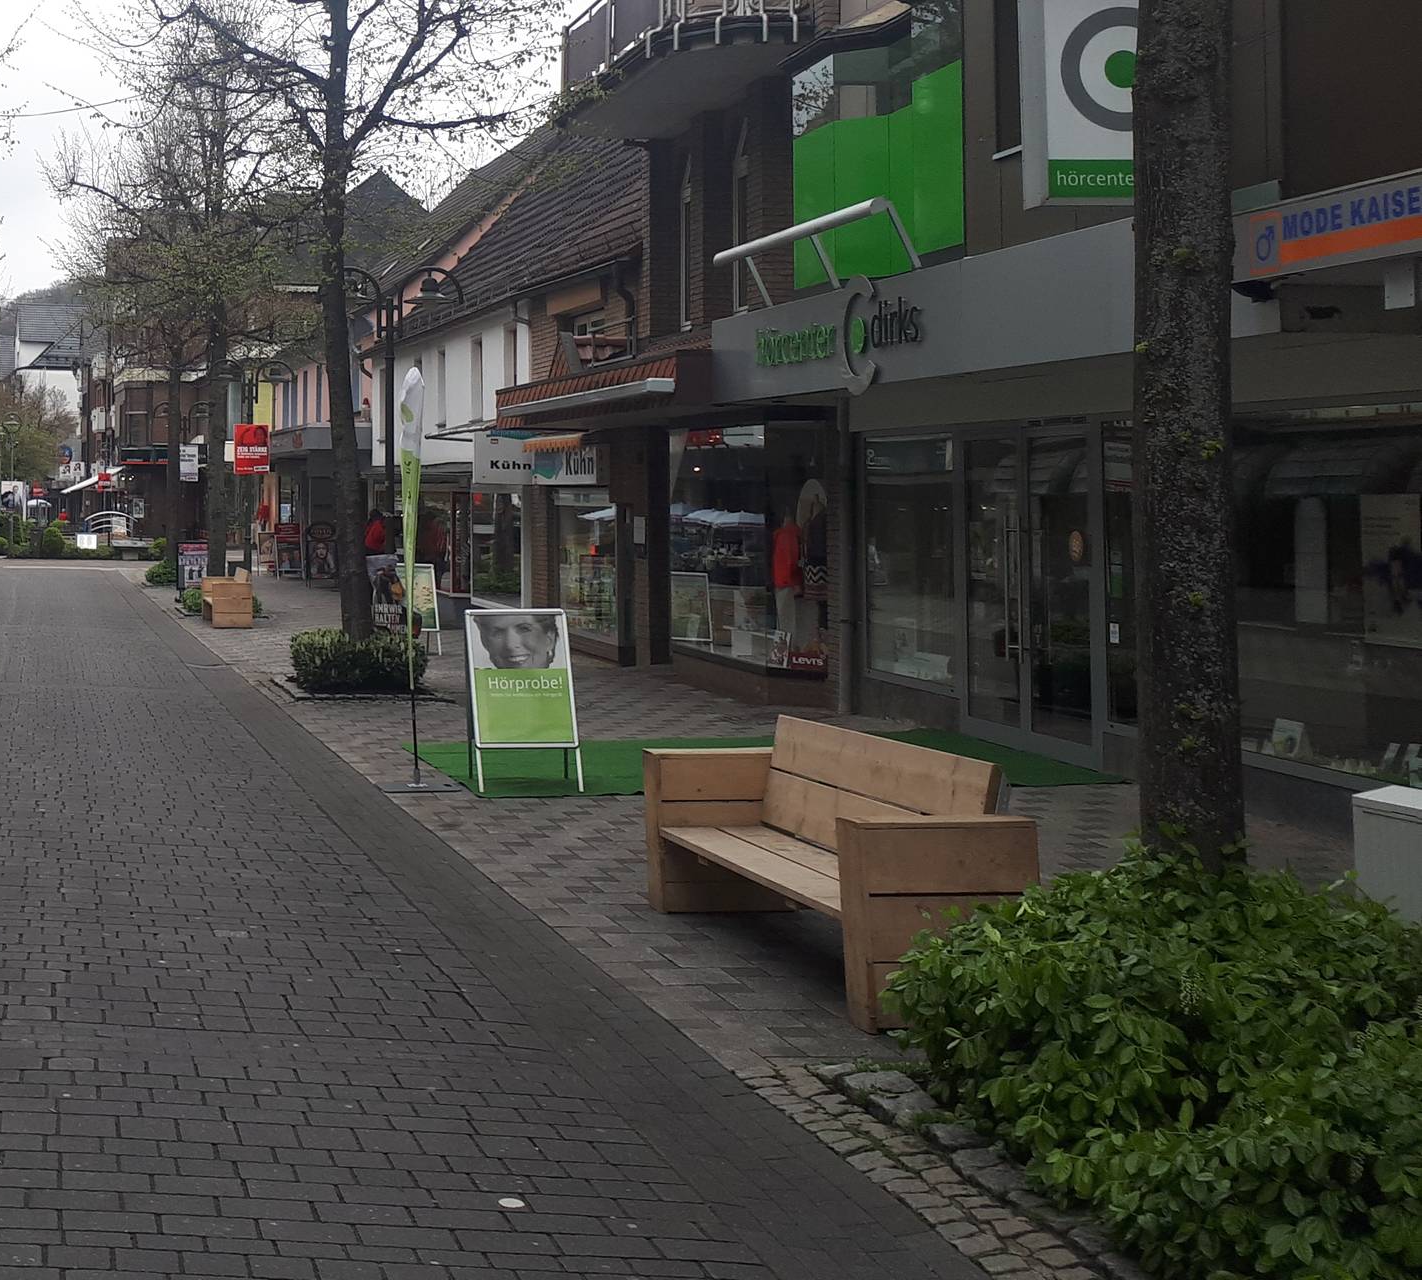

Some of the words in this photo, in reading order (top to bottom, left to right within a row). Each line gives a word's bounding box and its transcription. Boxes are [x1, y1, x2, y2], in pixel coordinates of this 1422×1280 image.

[1056, 170, 1134, 186] hörcente
[1282, 203, 1343, 241] MODE
[871, 296, 923, 348] dirks
[490, 459, 531, 470] Kühn
[565, 450, 595, 476] Kühn
[488, 675, 563, 692] Hörprobe!
